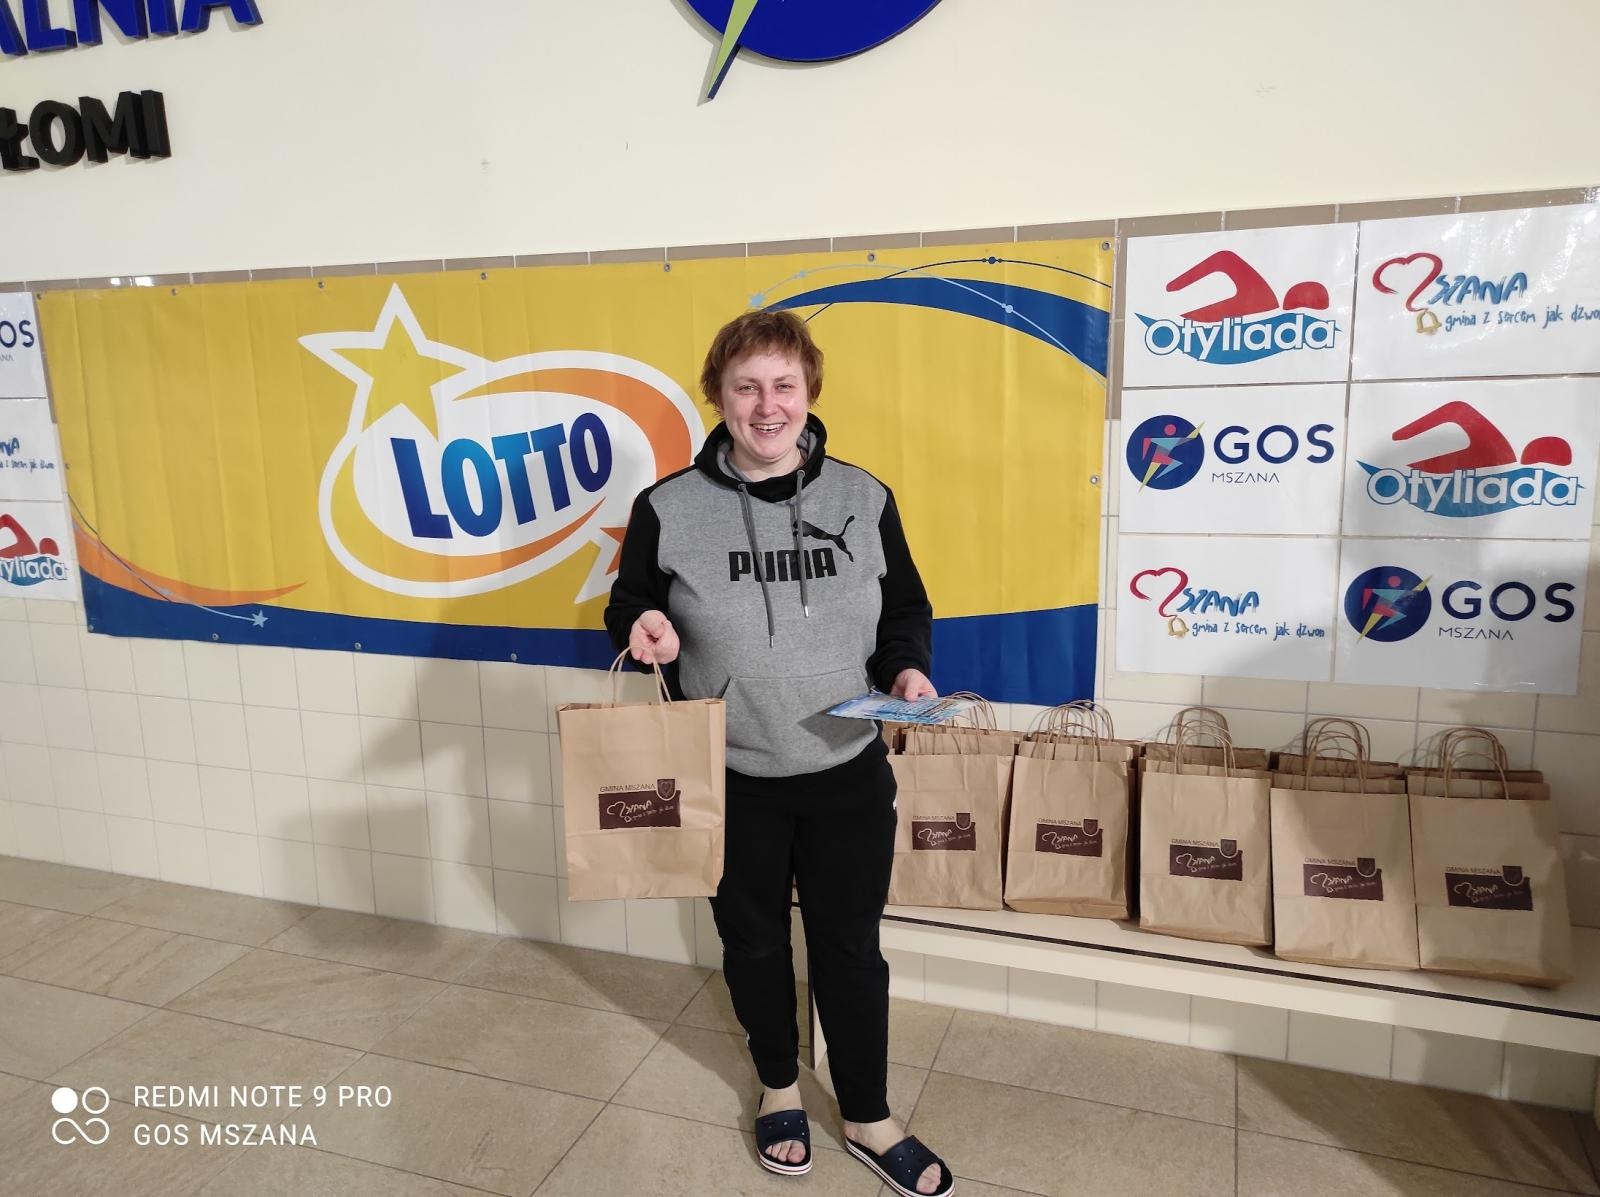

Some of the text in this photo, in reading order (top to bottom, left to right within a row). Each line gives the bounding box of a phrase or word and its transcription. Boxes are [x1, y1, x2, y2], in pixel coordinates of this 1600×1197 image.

[1543, 305, 1564, 329] jak
[1145, 313, 1336, 361] Otyliada
[1213, 423, 1335, 464] GOS
[390, 412, 612, 539] LOTTO
[1212, 472, 1280, 484] MSZANA
[1367, 468, 1578, 513] Otyliada
[728, 547, 837, 582] PUMA
[1441, 580, 1576, 623] GOS
[1192, 619, 1218, 637] gmina
[1273, 621, 1290, 641] jak
[1296, 623, 1325, 638] dzwon
[1438, 627, 1514, 641] MSZANA
